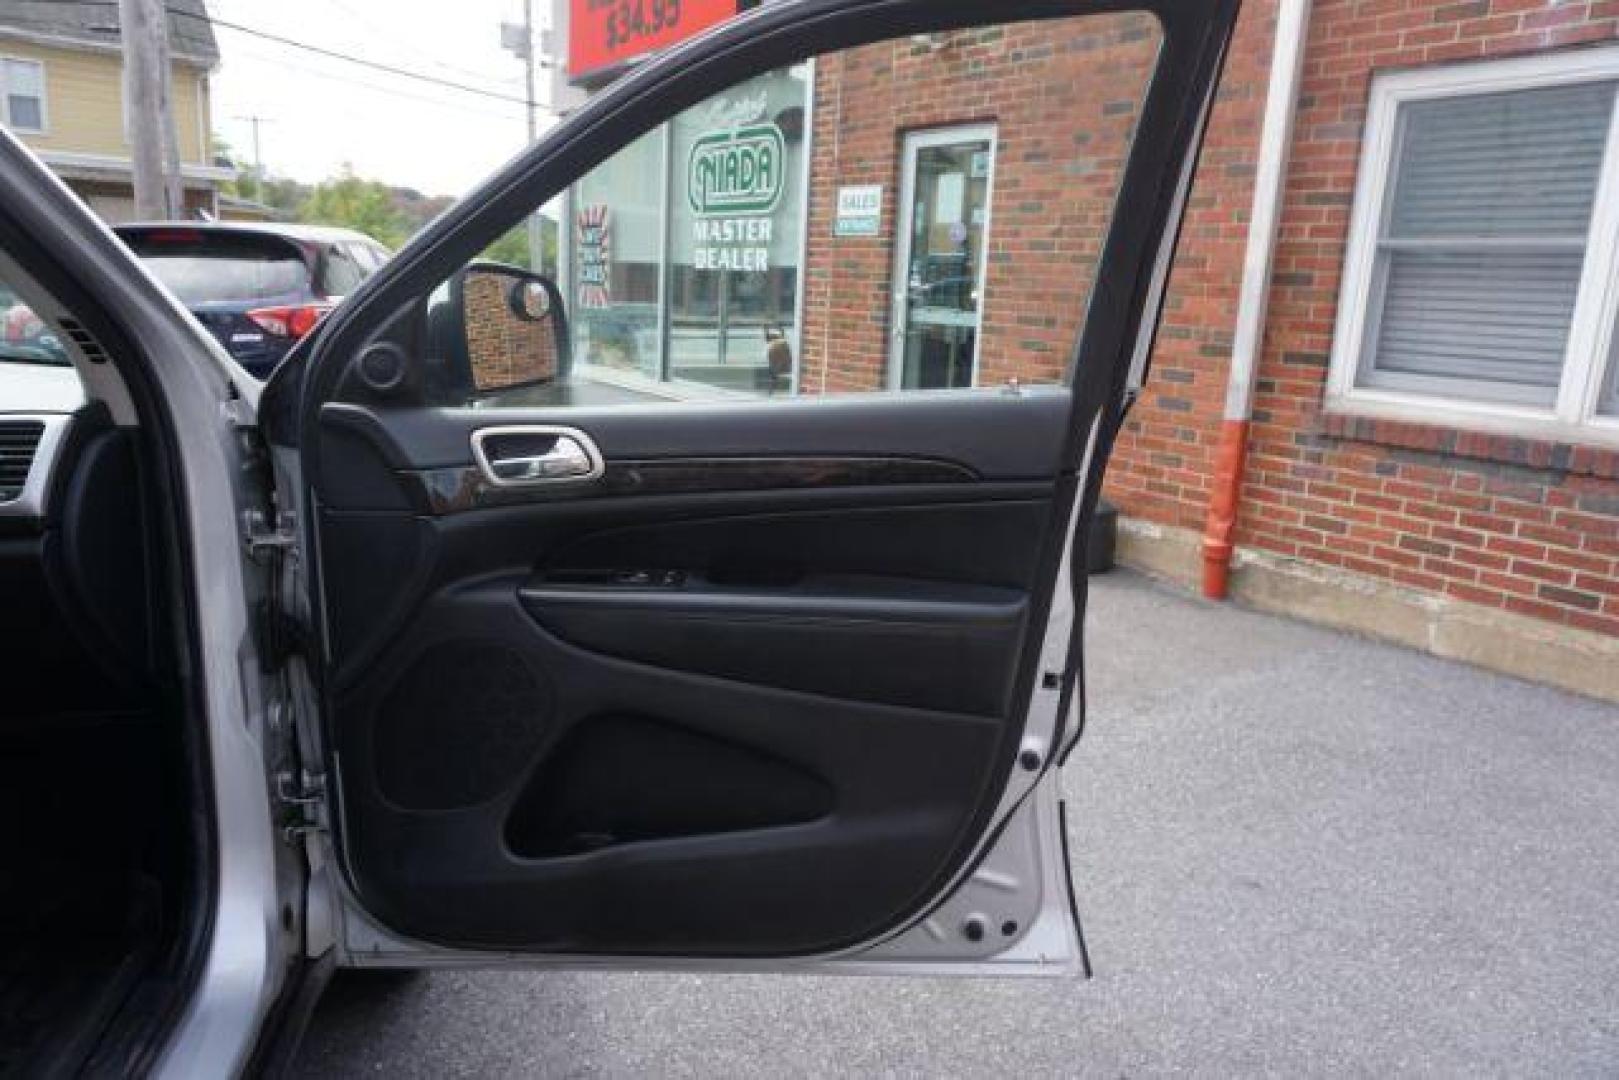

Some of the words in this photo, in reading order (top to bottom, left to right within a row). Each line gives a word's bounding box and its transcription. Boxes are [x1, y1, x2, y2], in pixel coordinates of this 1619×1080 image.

[696, 146, 773, 196] NIADA
[694, 219, 772, 242] MASTER
[695, 247, 769, 272] DEALER
